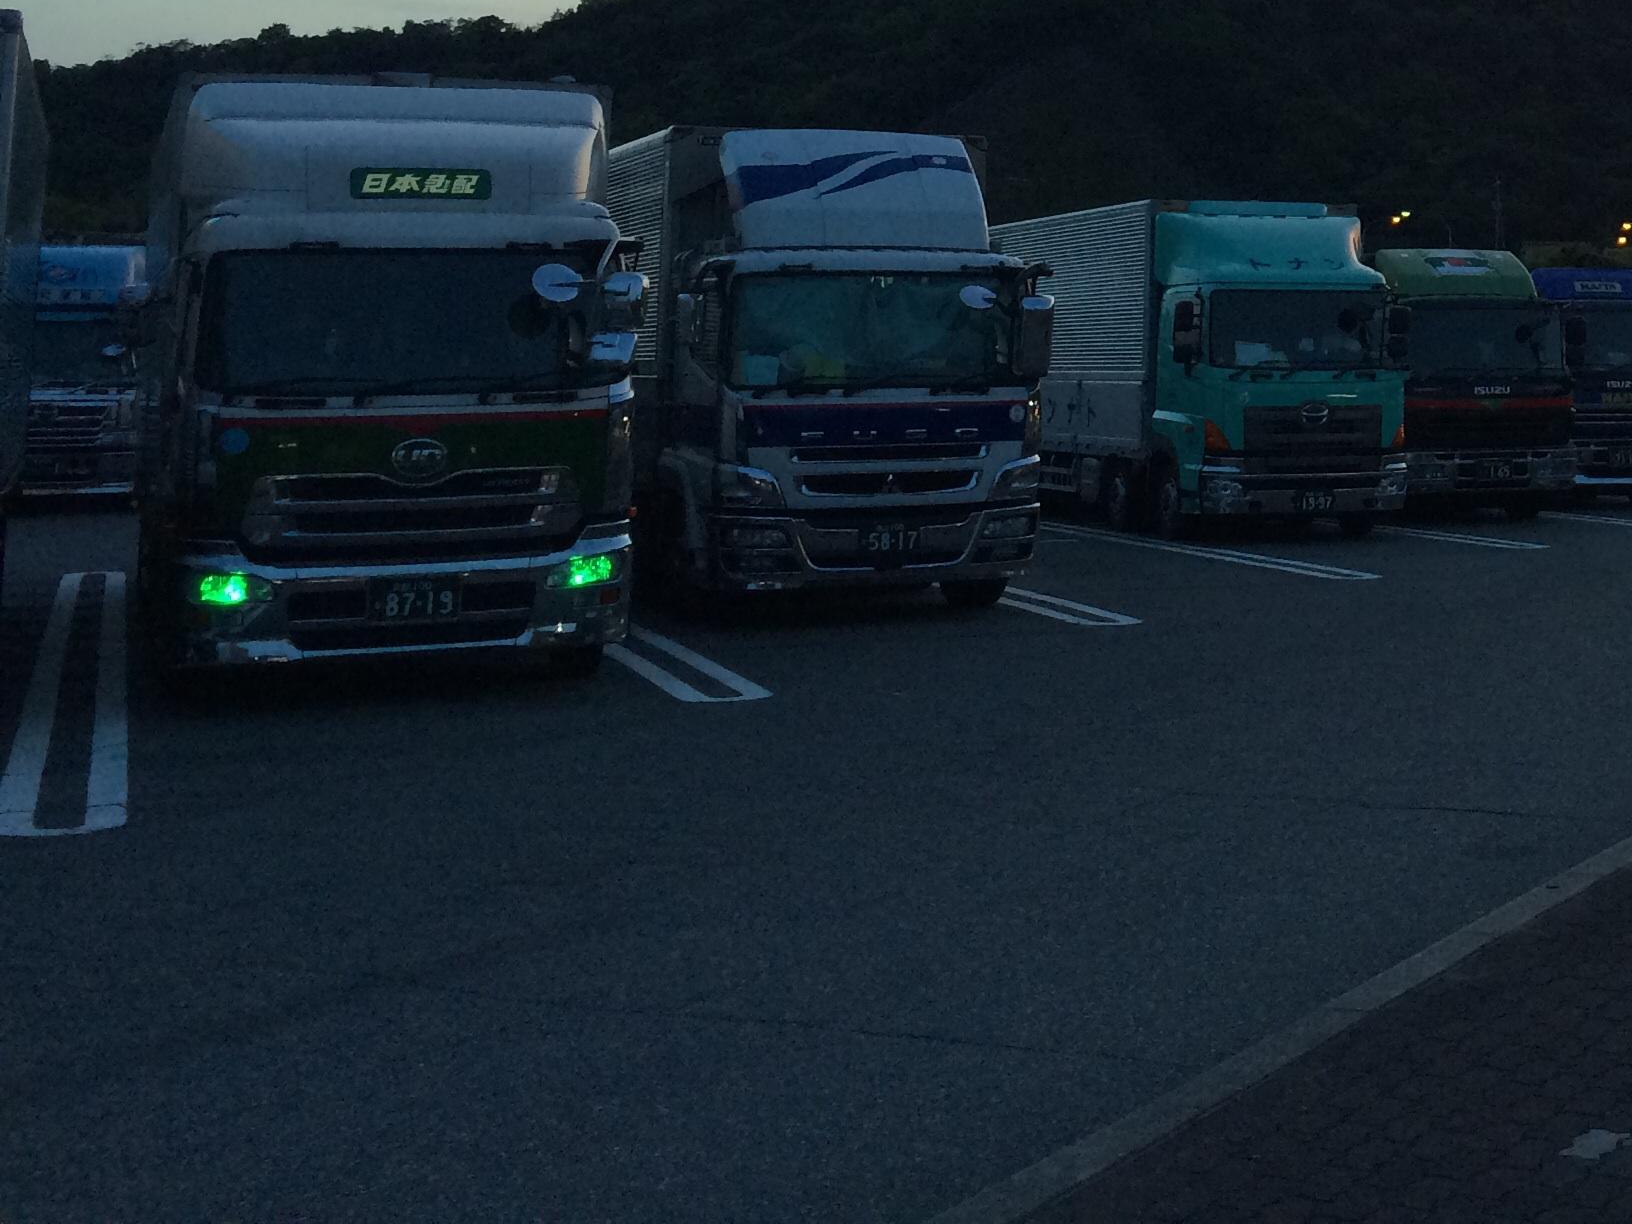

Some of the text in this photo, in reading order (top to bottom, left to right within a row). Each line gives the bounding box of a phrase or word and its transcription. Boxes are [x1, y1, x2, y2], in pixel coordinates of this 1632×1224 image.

[361, 173, 480, 194] 日本急配
[1474, 386, 1511, 396] ISUZU
